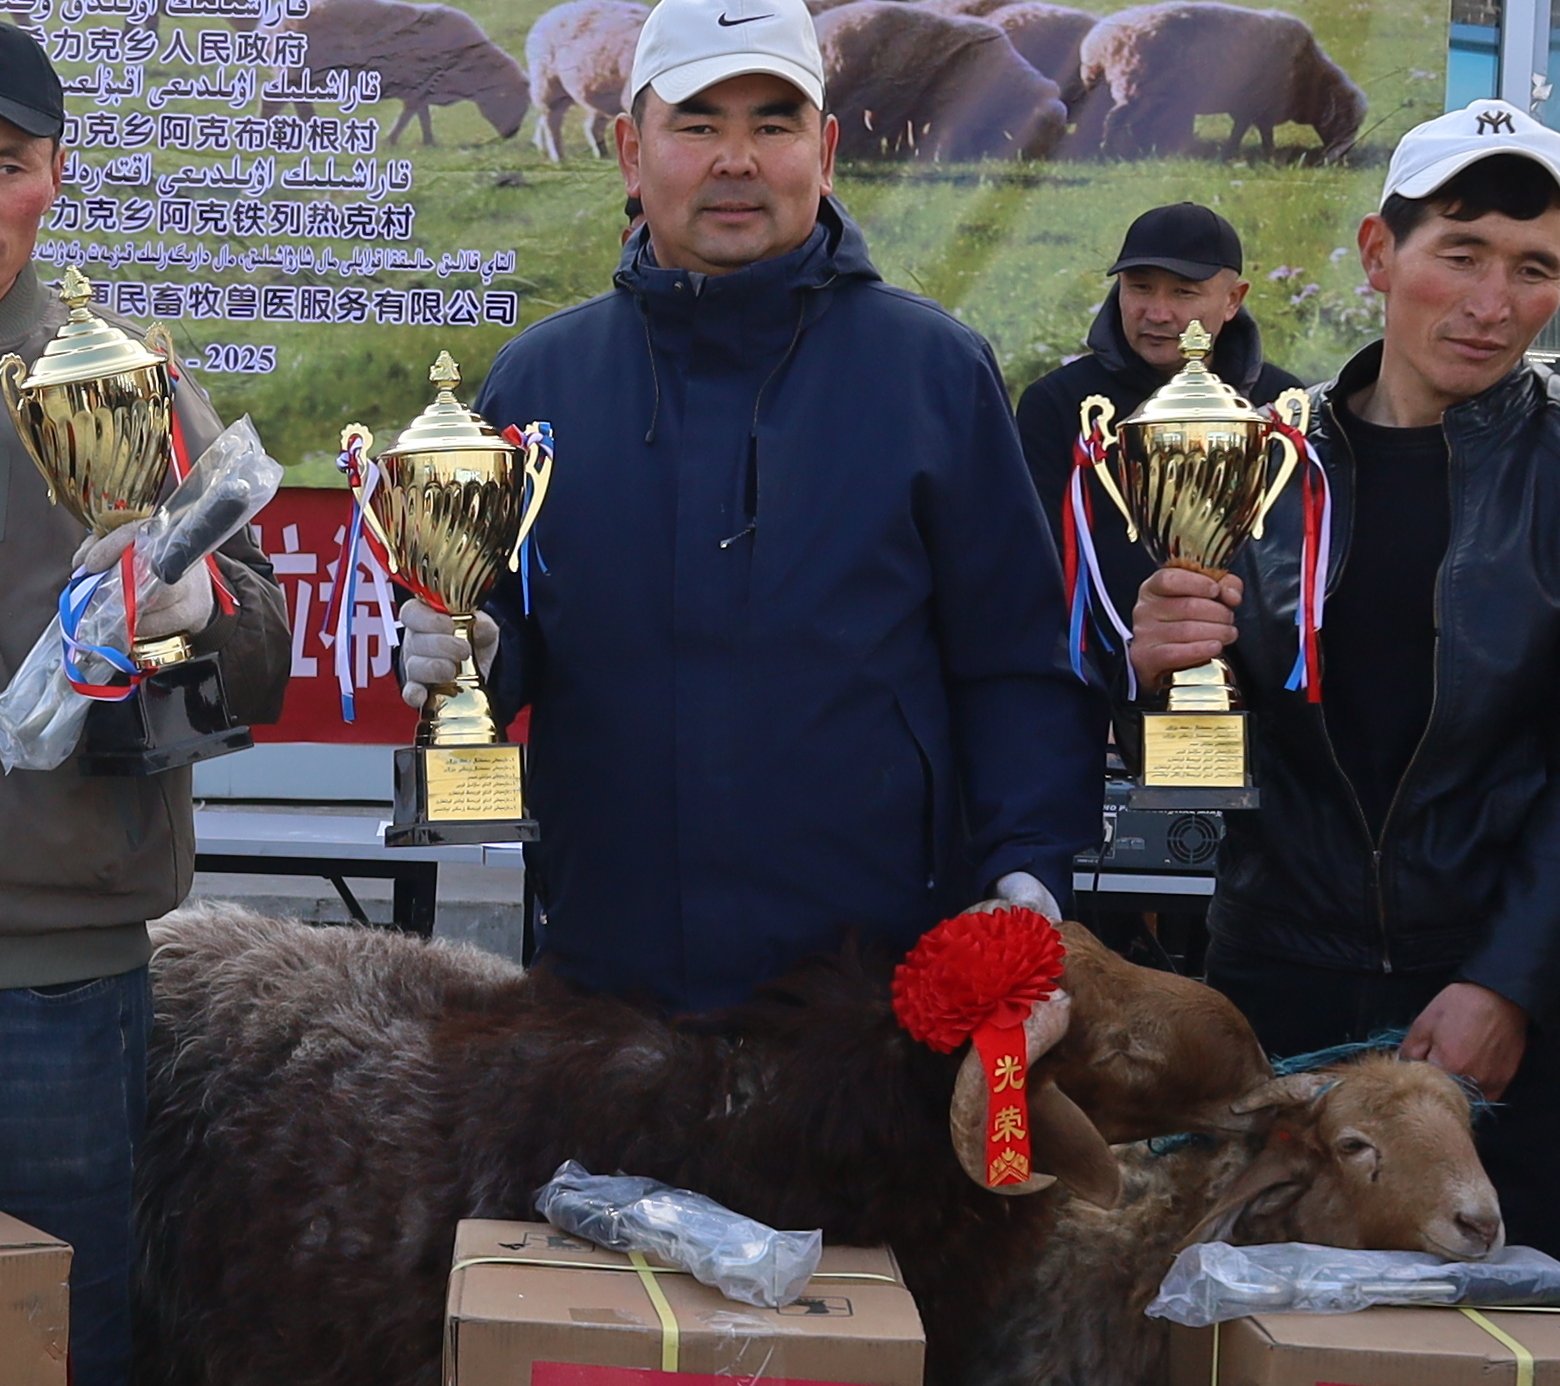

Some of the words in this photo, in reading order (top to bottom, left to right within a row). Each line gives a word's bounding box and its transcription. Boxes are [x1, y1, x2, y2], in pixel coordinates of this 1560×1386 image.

[38, 195, 415, 240] 力克乡阿克铁列热克村
[204, 343, 276, 373] 2025
[991, 1055, 1026, 1144] 光荣
